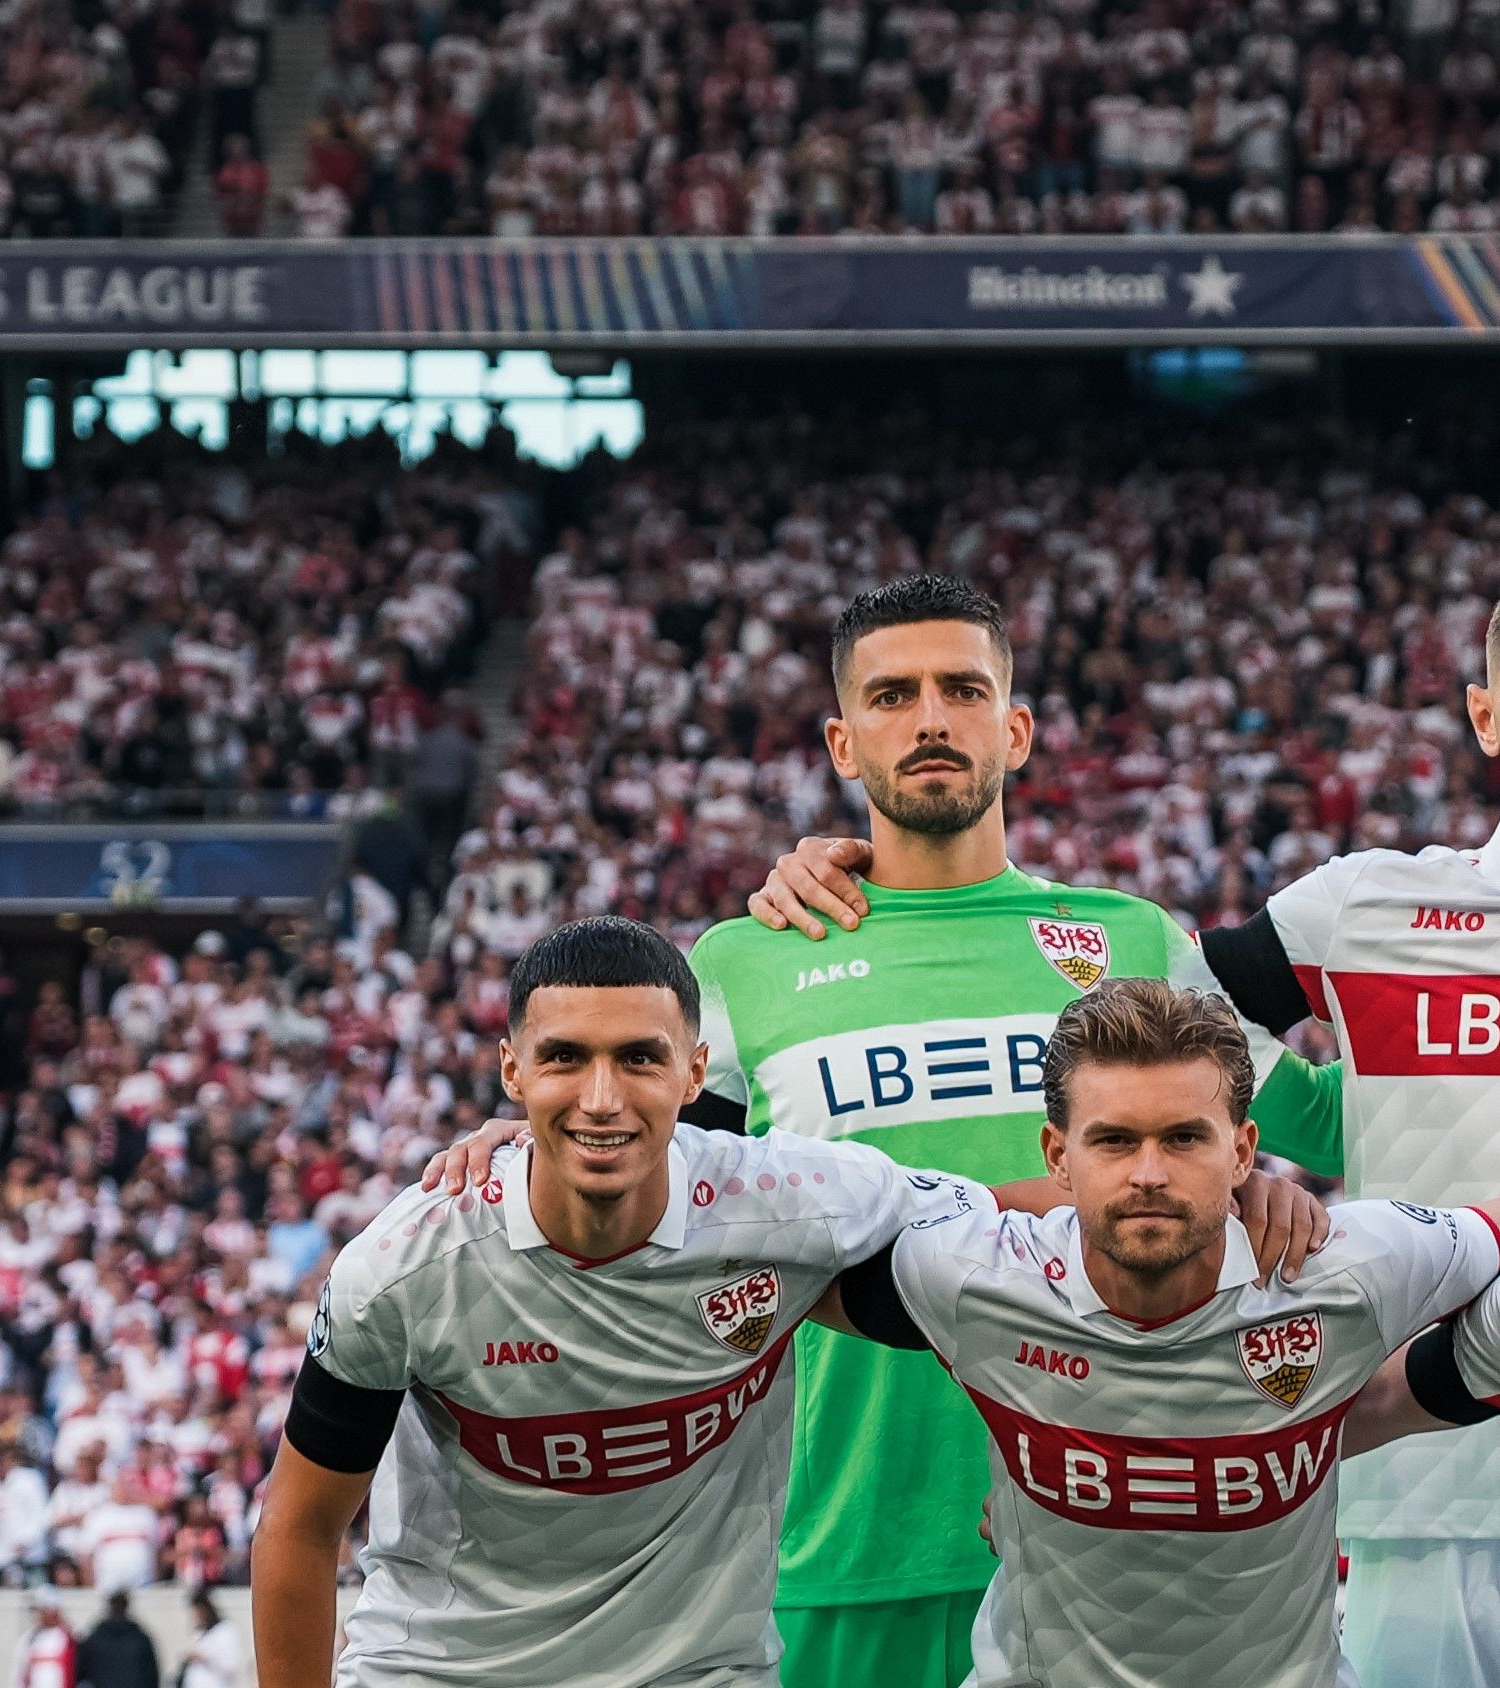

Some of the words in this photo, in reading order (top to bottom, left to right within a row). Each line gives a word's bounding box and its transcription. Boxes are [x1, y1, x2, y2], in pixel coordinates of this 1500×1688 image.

[29, 265, 268, 321] LEAGUE
[968, 264, 1167, 307] Heineken
[1411, 906, 1485, 932] JAKO
[795, 959, 870, 992] JAKO
[482, 1341, 559, 1366] JAKO
[1015, 1341, 1090, 1380] JAKO
